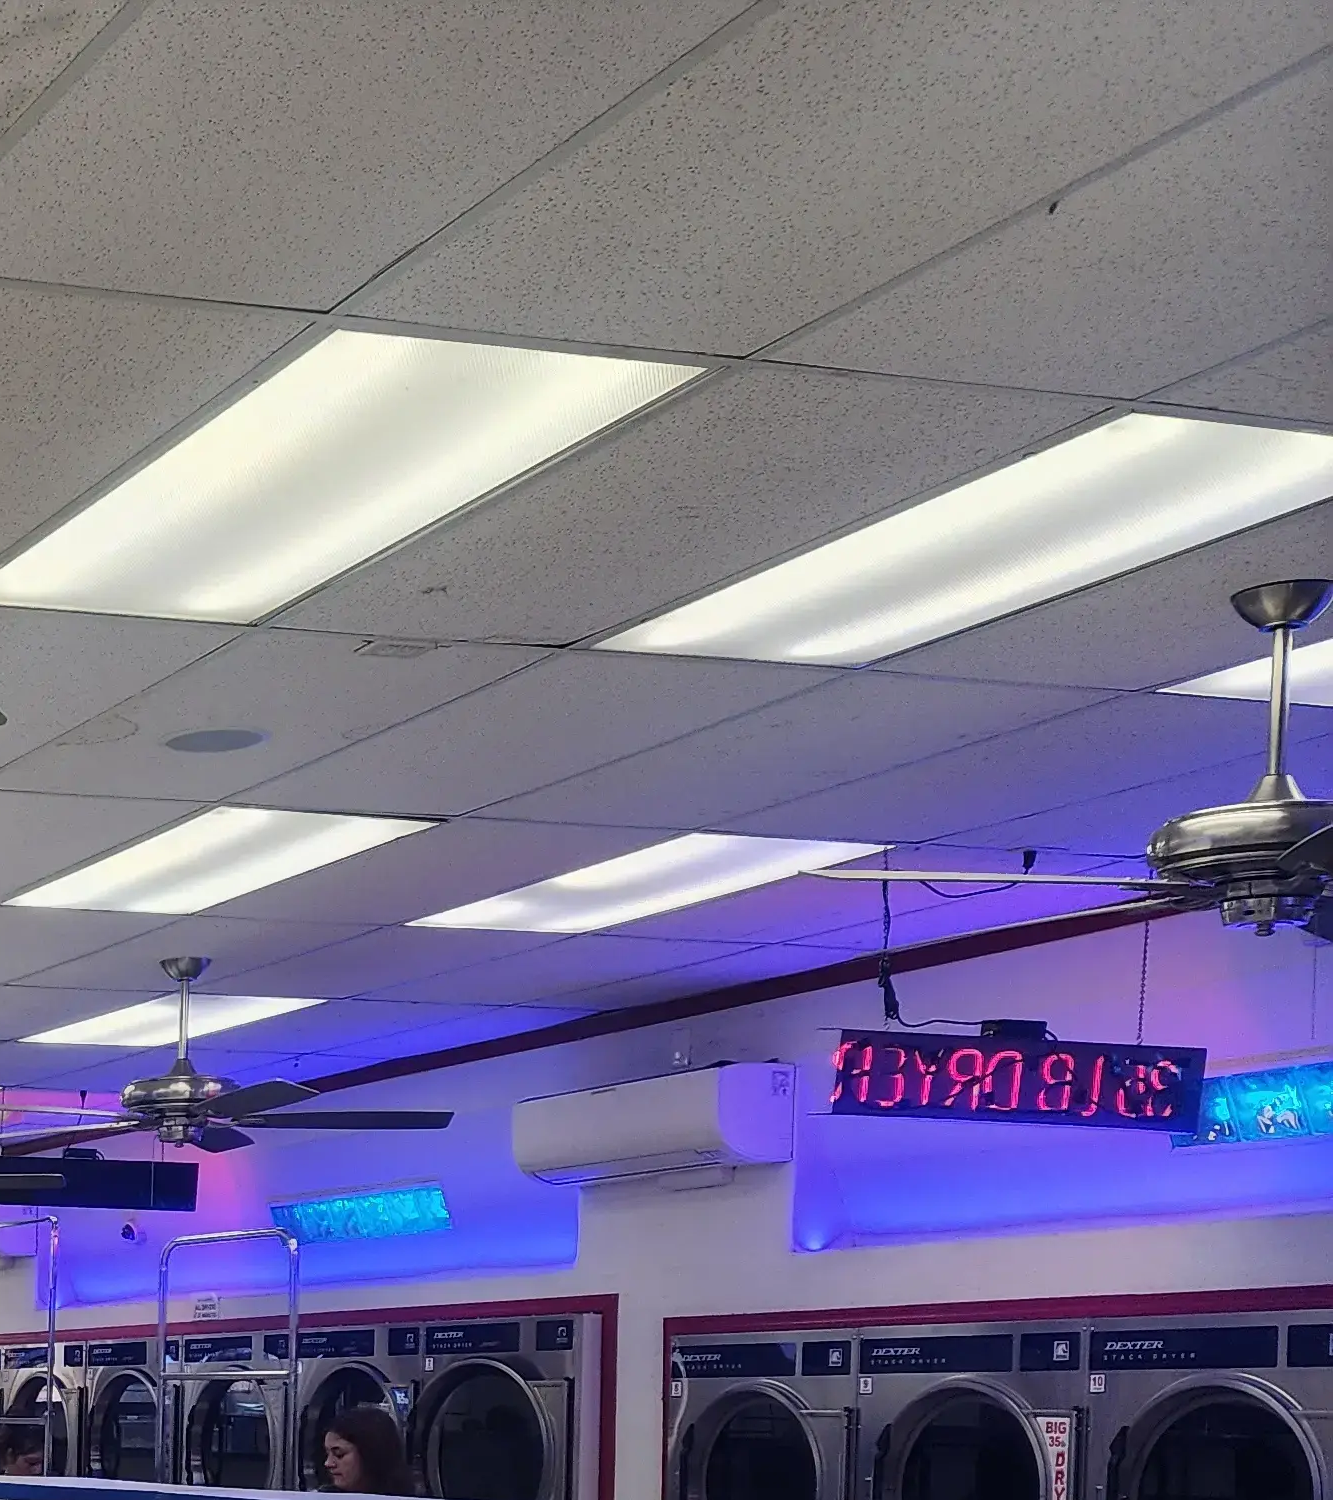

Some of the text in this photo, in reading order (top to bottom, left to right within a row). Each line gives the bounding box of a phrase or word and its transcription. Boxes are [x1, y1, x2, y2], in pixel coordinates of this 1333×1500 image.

[1103, 1340, 1164, 1350] DEXTER
[871, 1347, 921, 1356] DEXTER
[1091, 1375, 1104, 1388] 10
[1045, 1421, 1067, 1435] BIG
